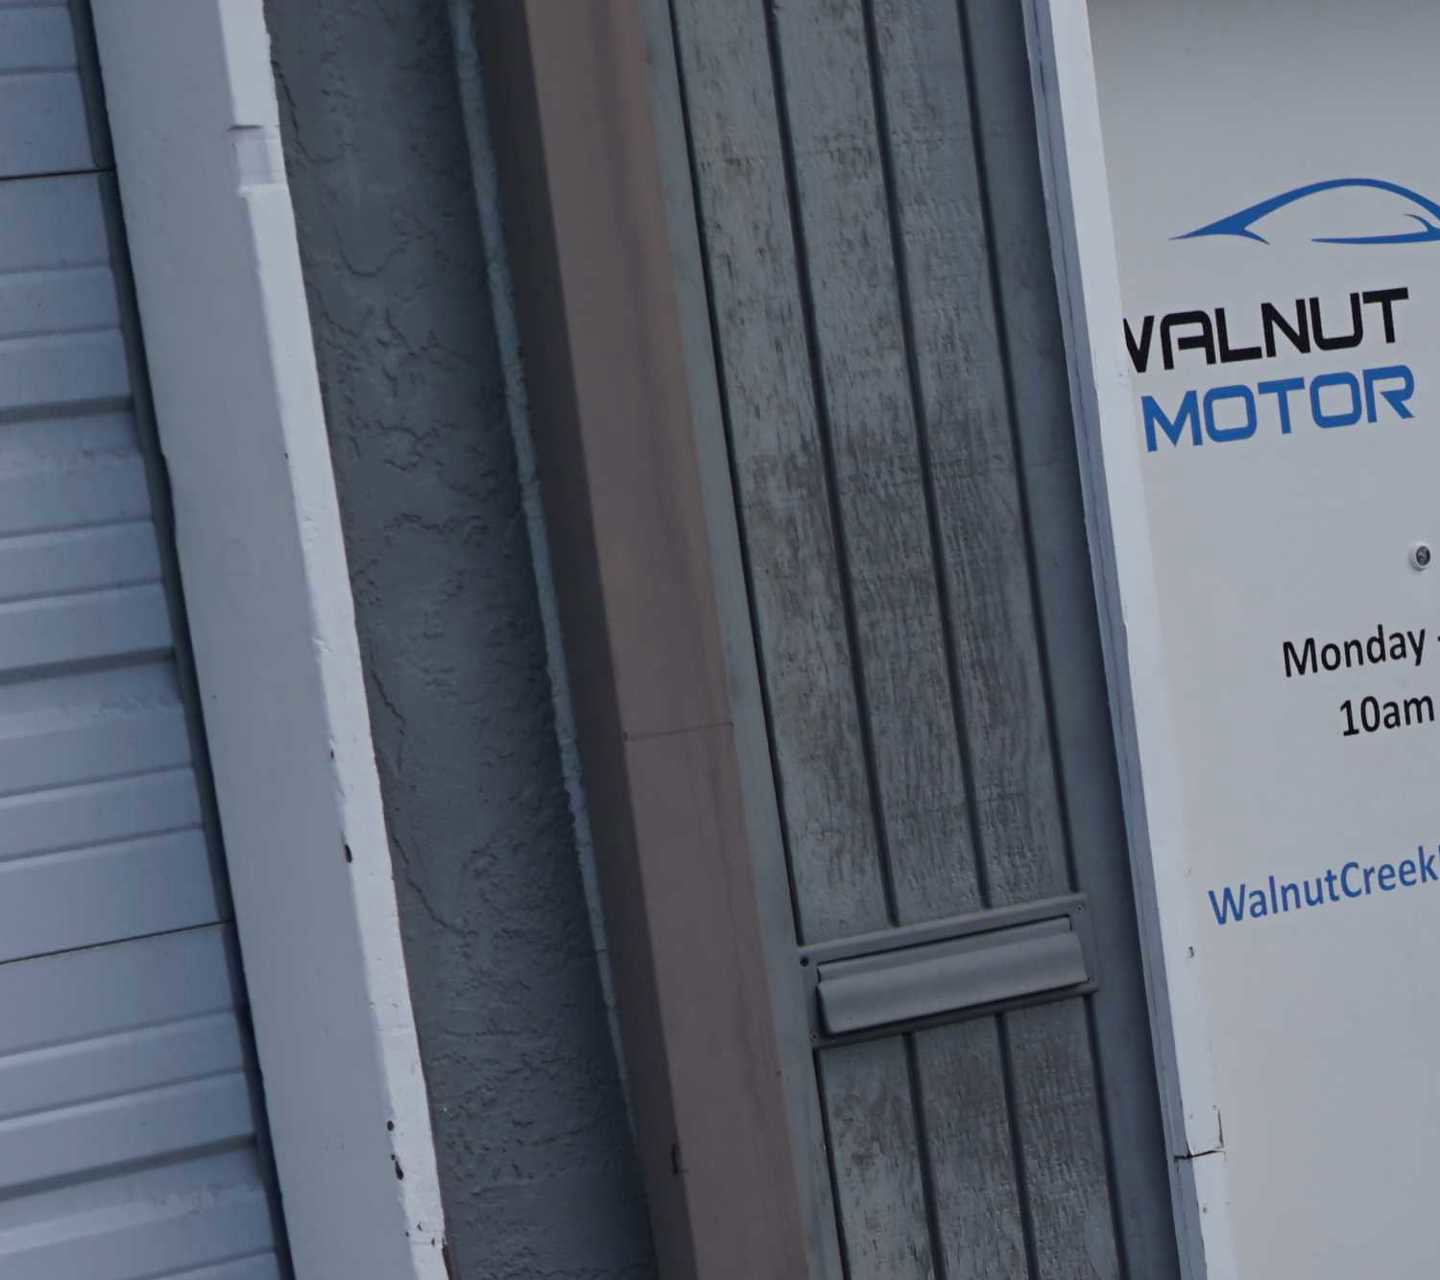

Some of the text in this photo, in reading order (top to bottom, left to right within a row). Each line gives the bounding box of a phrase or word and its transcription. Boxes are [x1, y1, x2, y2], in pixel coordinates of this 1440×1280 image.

[1140, 364, 1416, 453] MOTOR
[1282, 623, 1426, 678] Monday
[1339, 694, 1436, 737] 10am
